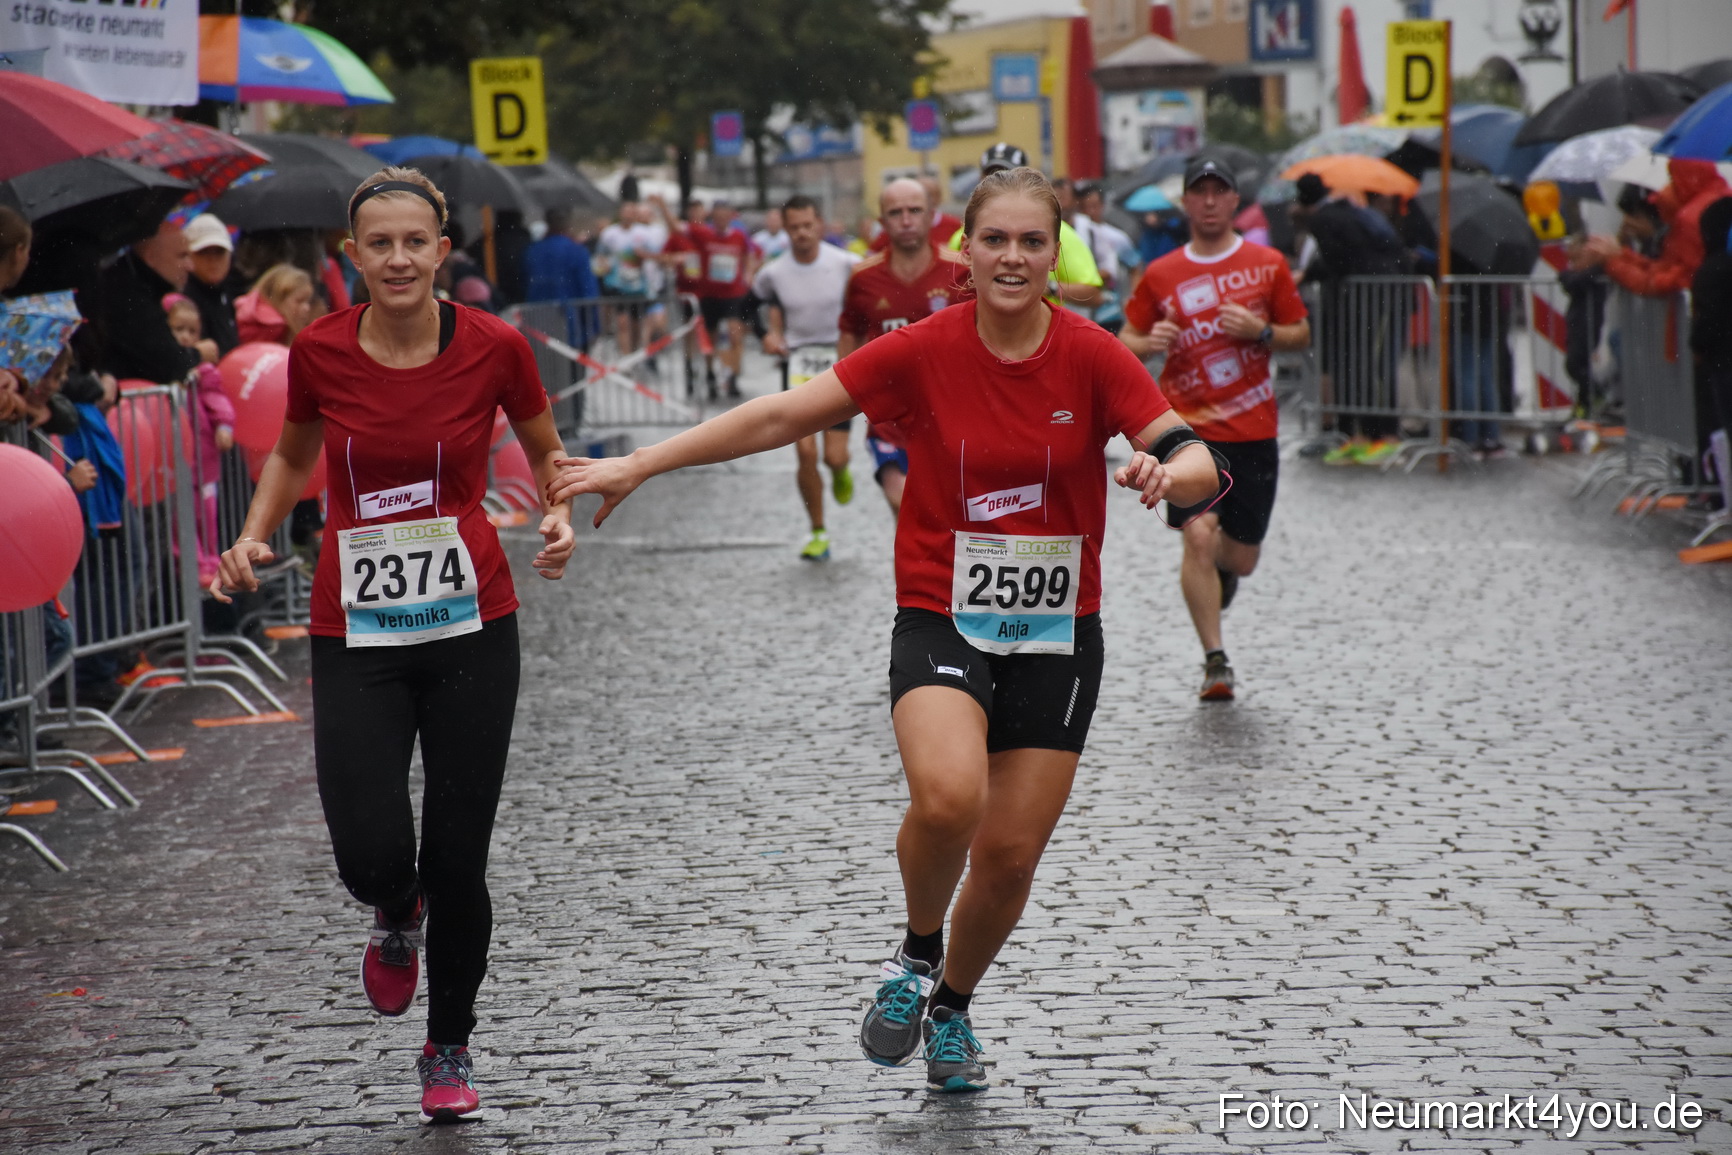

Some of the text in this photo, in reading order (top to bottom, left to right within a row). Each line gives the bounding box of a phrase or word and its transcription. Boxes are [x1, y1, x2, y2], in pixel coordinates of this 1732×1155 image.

[1404, 54, 1434, 102] D
[493, 92, 526, 140] D
[378, 492, 412, 509] DEHN
[988, 494, 1021, 513] DEHN
[394, 522, 456, 541] BOCK
[349, 539, 387, 550] NeuerMarkt
[966, 546, 1008, 556] NeuerMarkt
[1016, 541, 1071, 555] BOCK
[354, 547, 465, 603] 2374
[967, 563, 1070, 609] 2599
[958, 602, 963, 611] B
[375, 607, 450, 628] Veronika
[998, 620, 1029, 640] Anja
